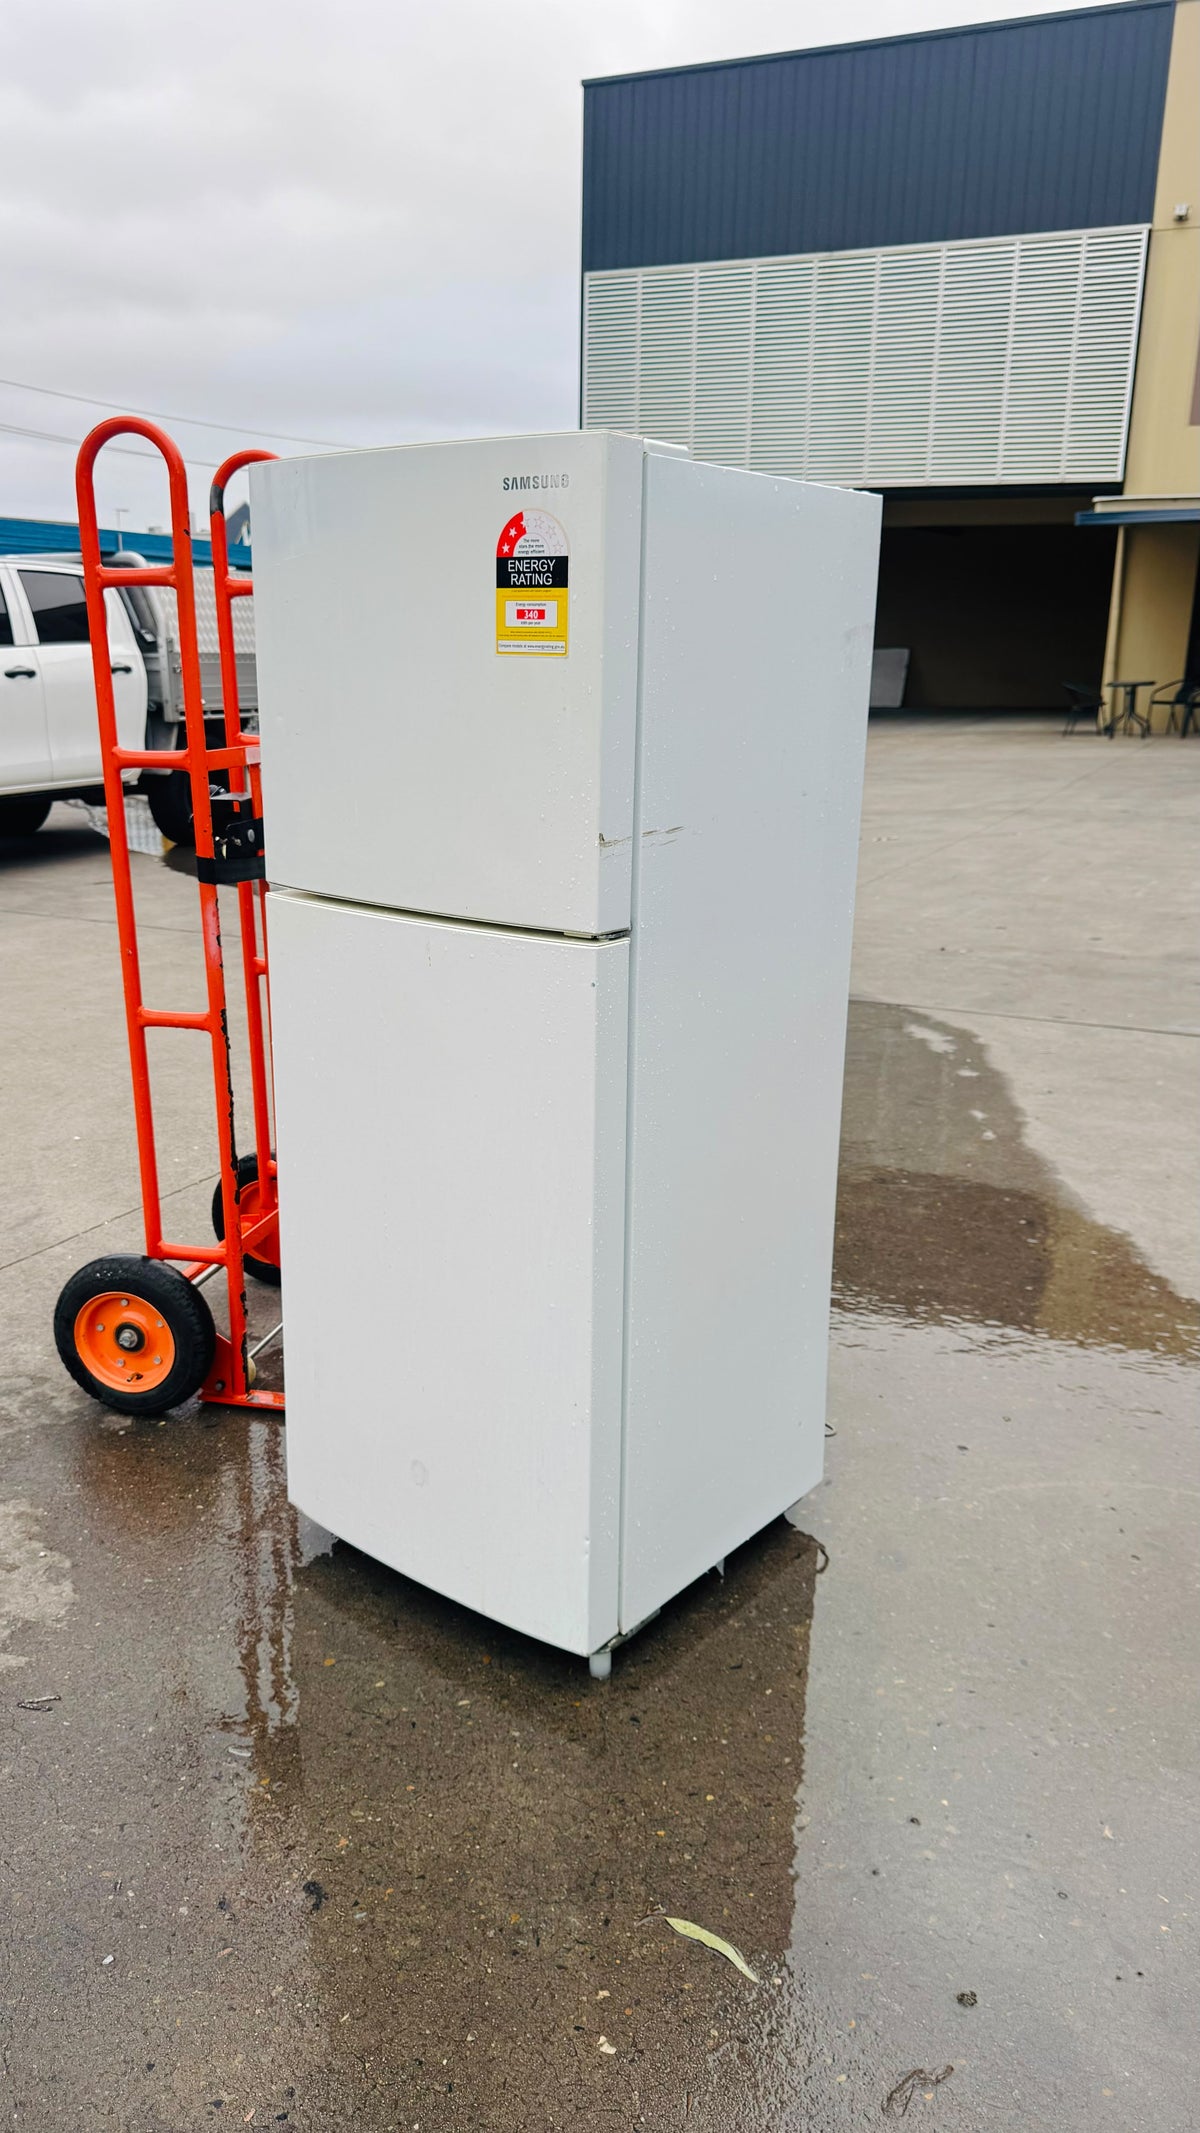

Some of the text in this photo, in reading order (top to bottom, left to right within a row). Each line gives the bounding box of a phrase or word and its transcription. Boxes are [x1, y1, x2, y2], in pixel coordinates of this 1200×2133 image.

[503, 474, 569, 490] SAMSUNG
[507, 559, 556, 572] ENERGY
[510, 573, 553, 585] RATING
[524, 610, 539, 619] 340
